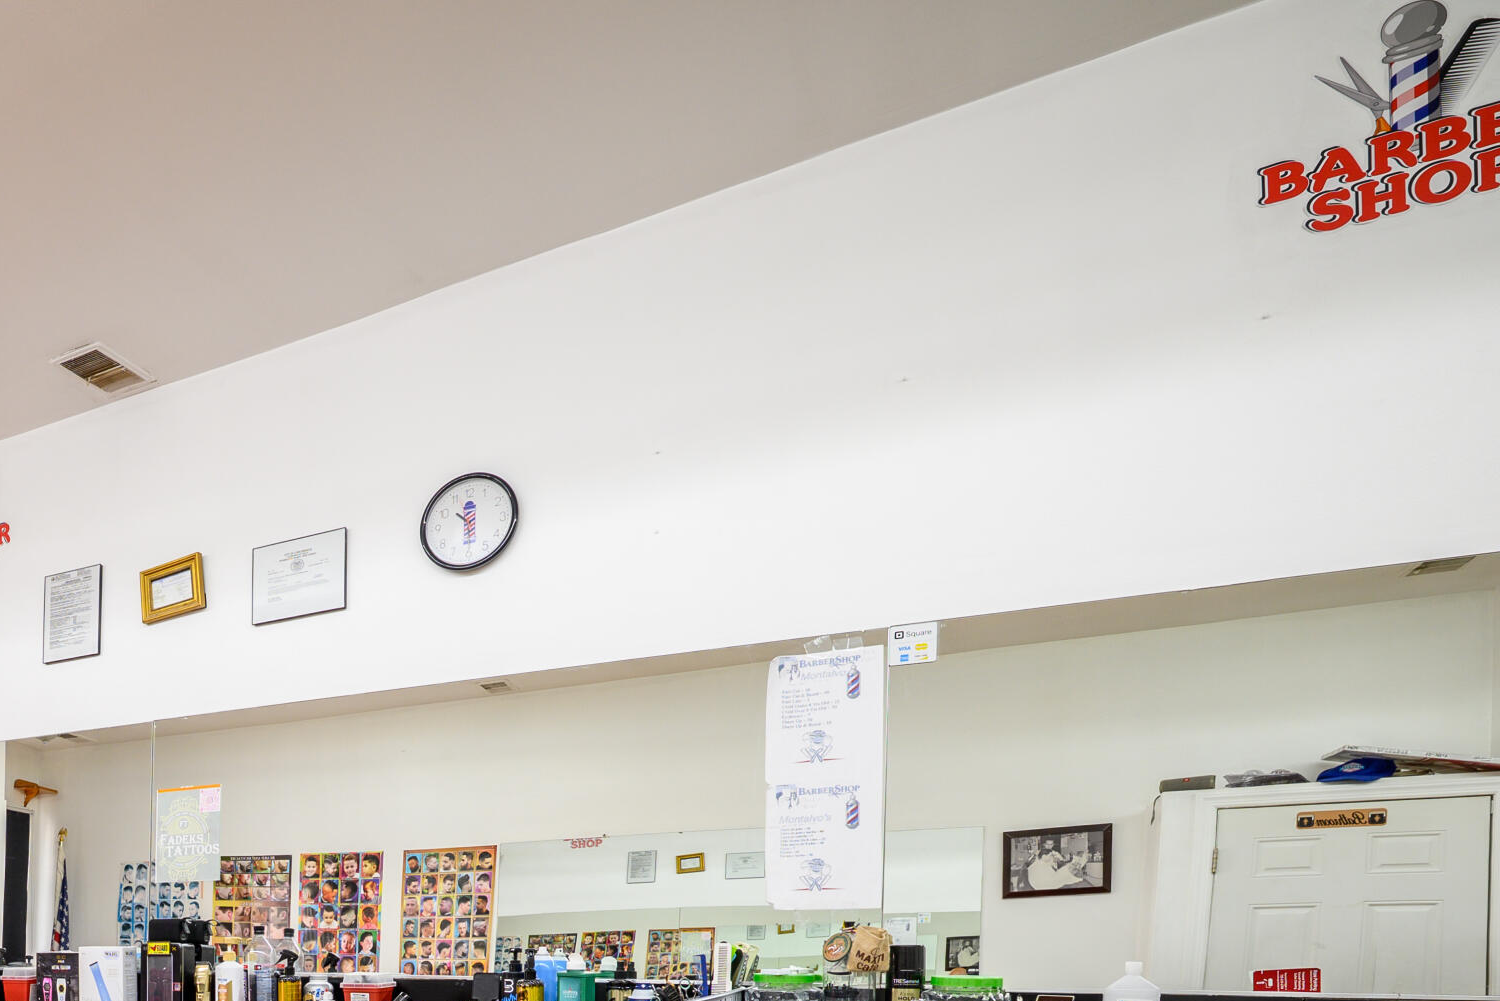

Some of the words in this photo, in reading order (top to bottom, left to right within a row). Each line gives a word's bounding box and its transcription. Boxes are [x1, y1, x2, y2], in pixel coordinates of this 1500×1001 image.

[1258, 101, 1500, 206] BARBE
[465, 487, 475, 498] 12
[906, 630, 932, 638] Square
[160, 833, 204, 849] FADEKS
[571, 838, 603, 849] SHOP
[165, 843, 220, 858] TATTOOS
